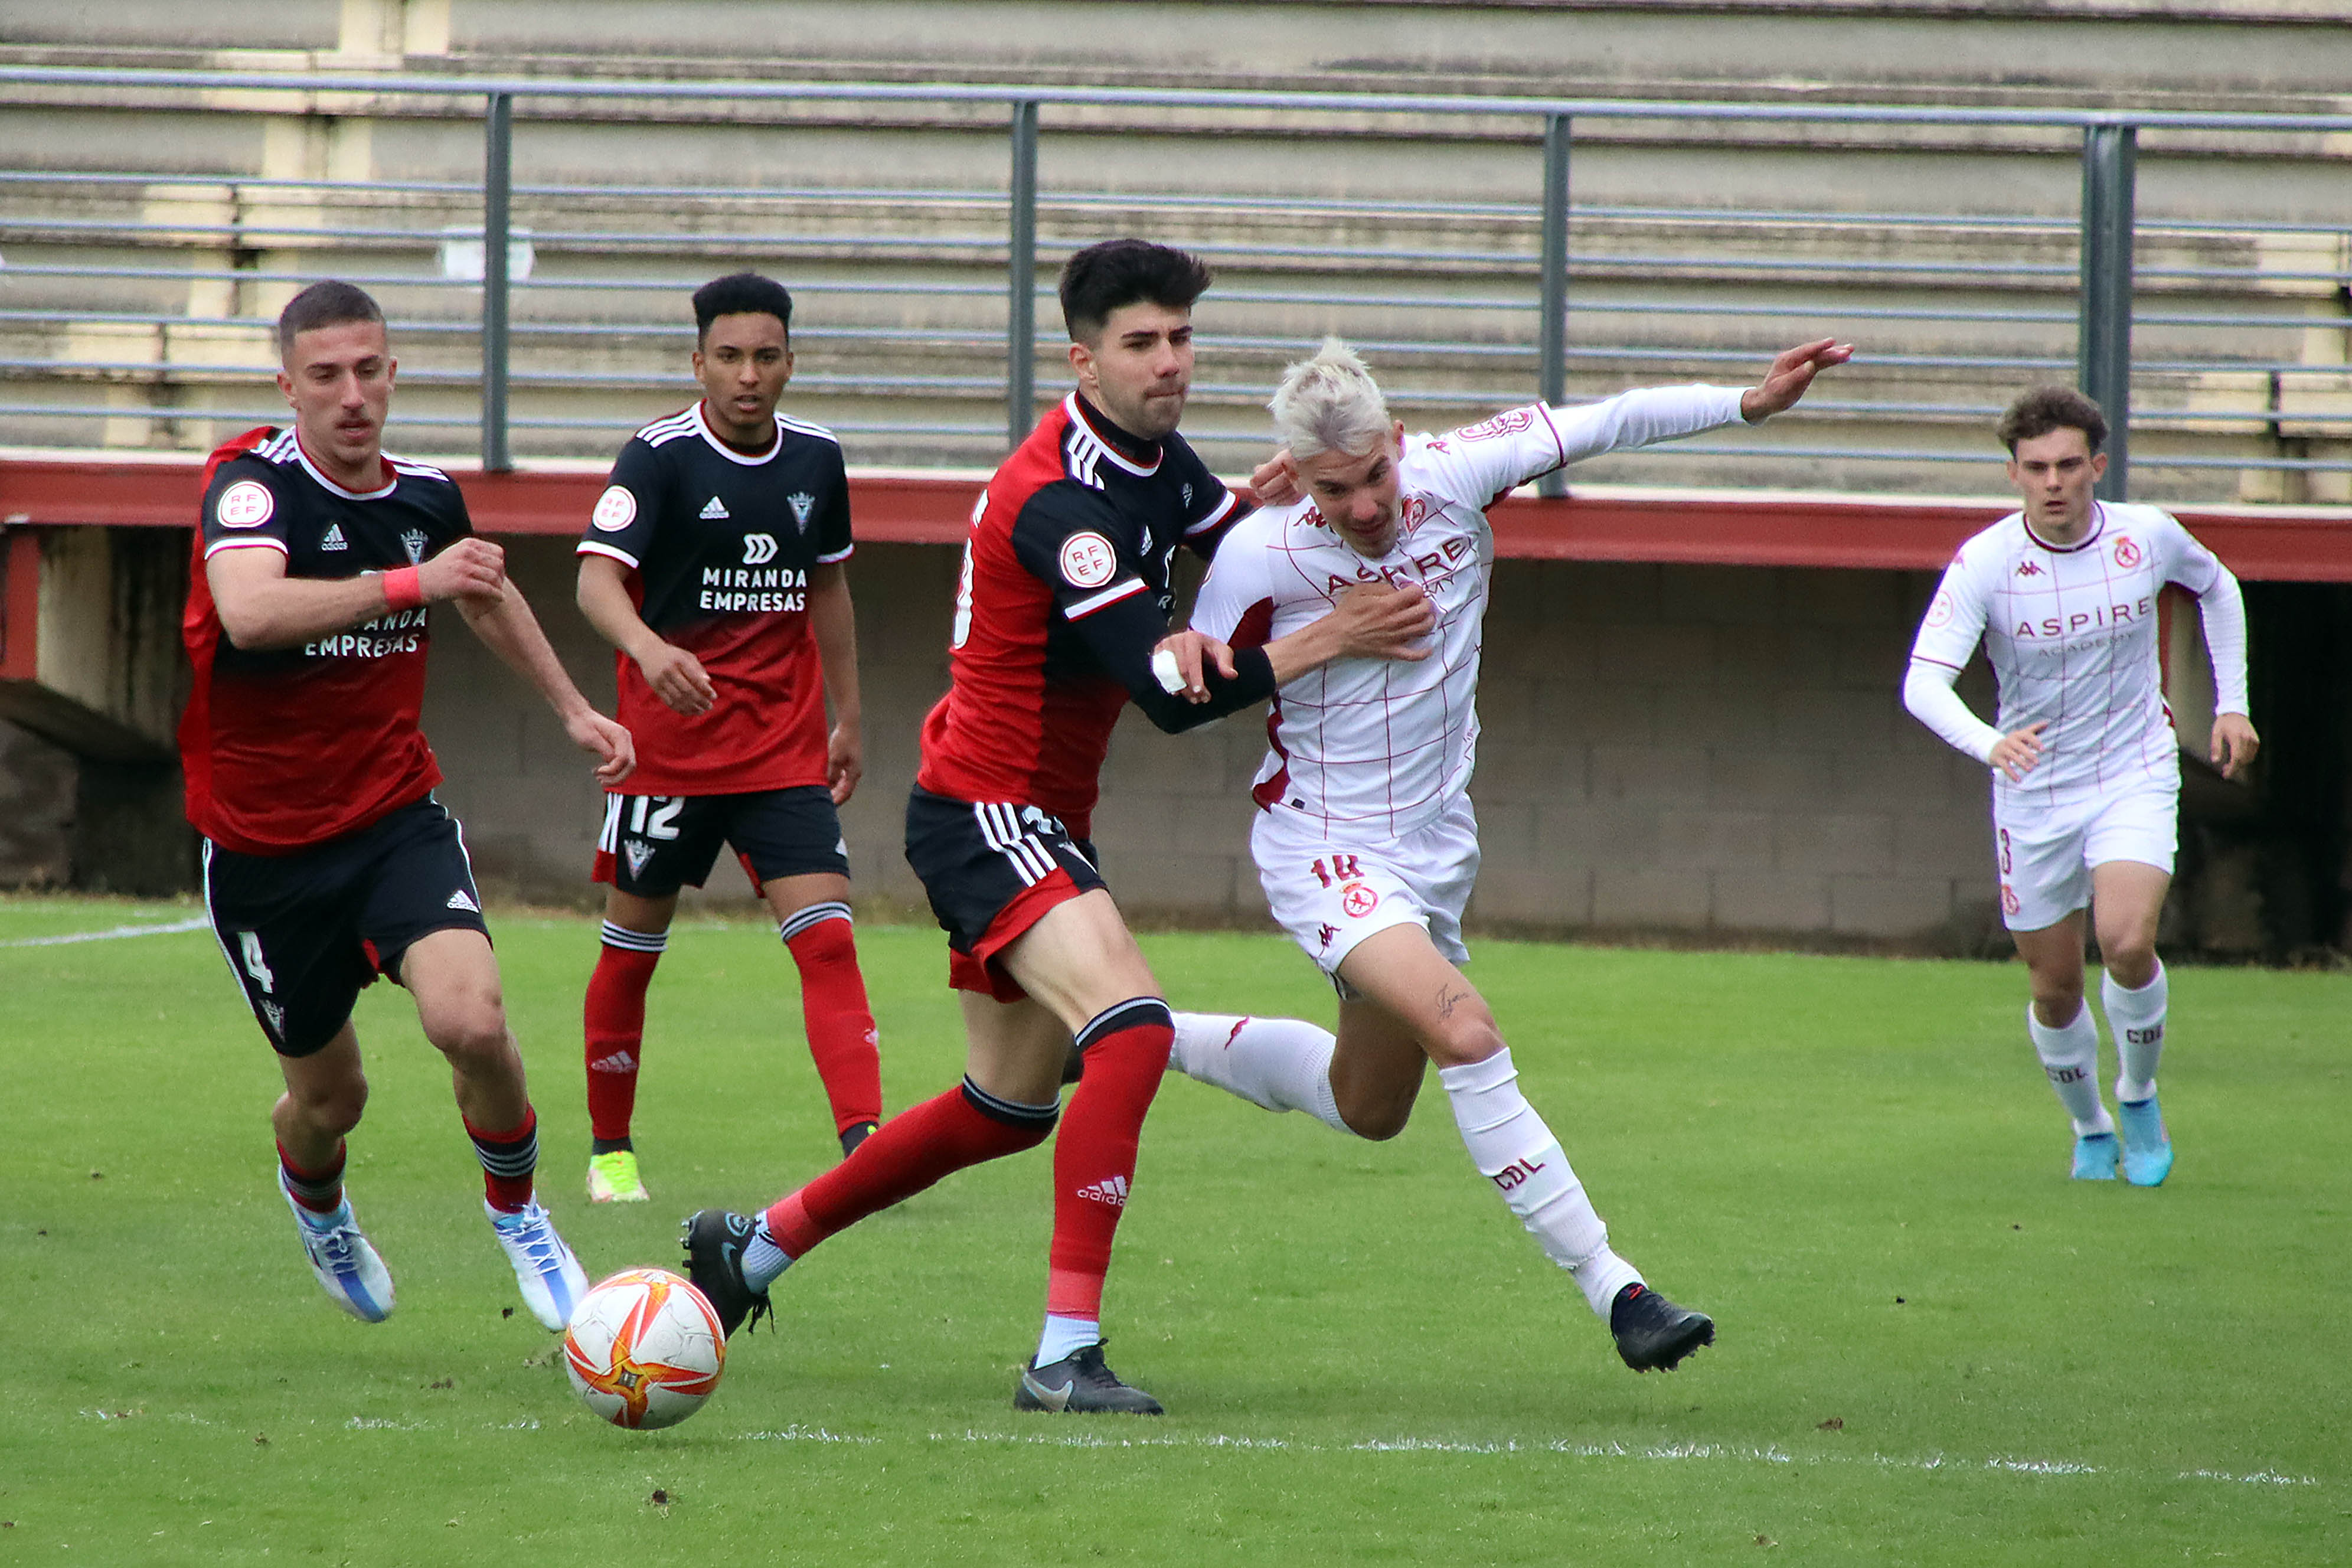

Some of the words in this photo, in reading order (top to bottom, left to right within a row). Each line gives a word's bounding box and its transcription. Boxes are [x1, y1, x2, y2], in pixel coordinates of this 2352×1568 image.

[702, 567, 807, 588] MIRANDA
[700, 590, 805, 612] EMPRESAS
[364, 607, 427, 631] ANDA
[2017, 596, 2151, 637] ASPIRE
[305, 633, 420, 658] EMPRESAS
[629, 795, 686, 839] 12
[237, 931, 273, 994] 4
[1492, 1158, 1546, 1191] CDL
[1077, 1189, 1125, 1207] adida
